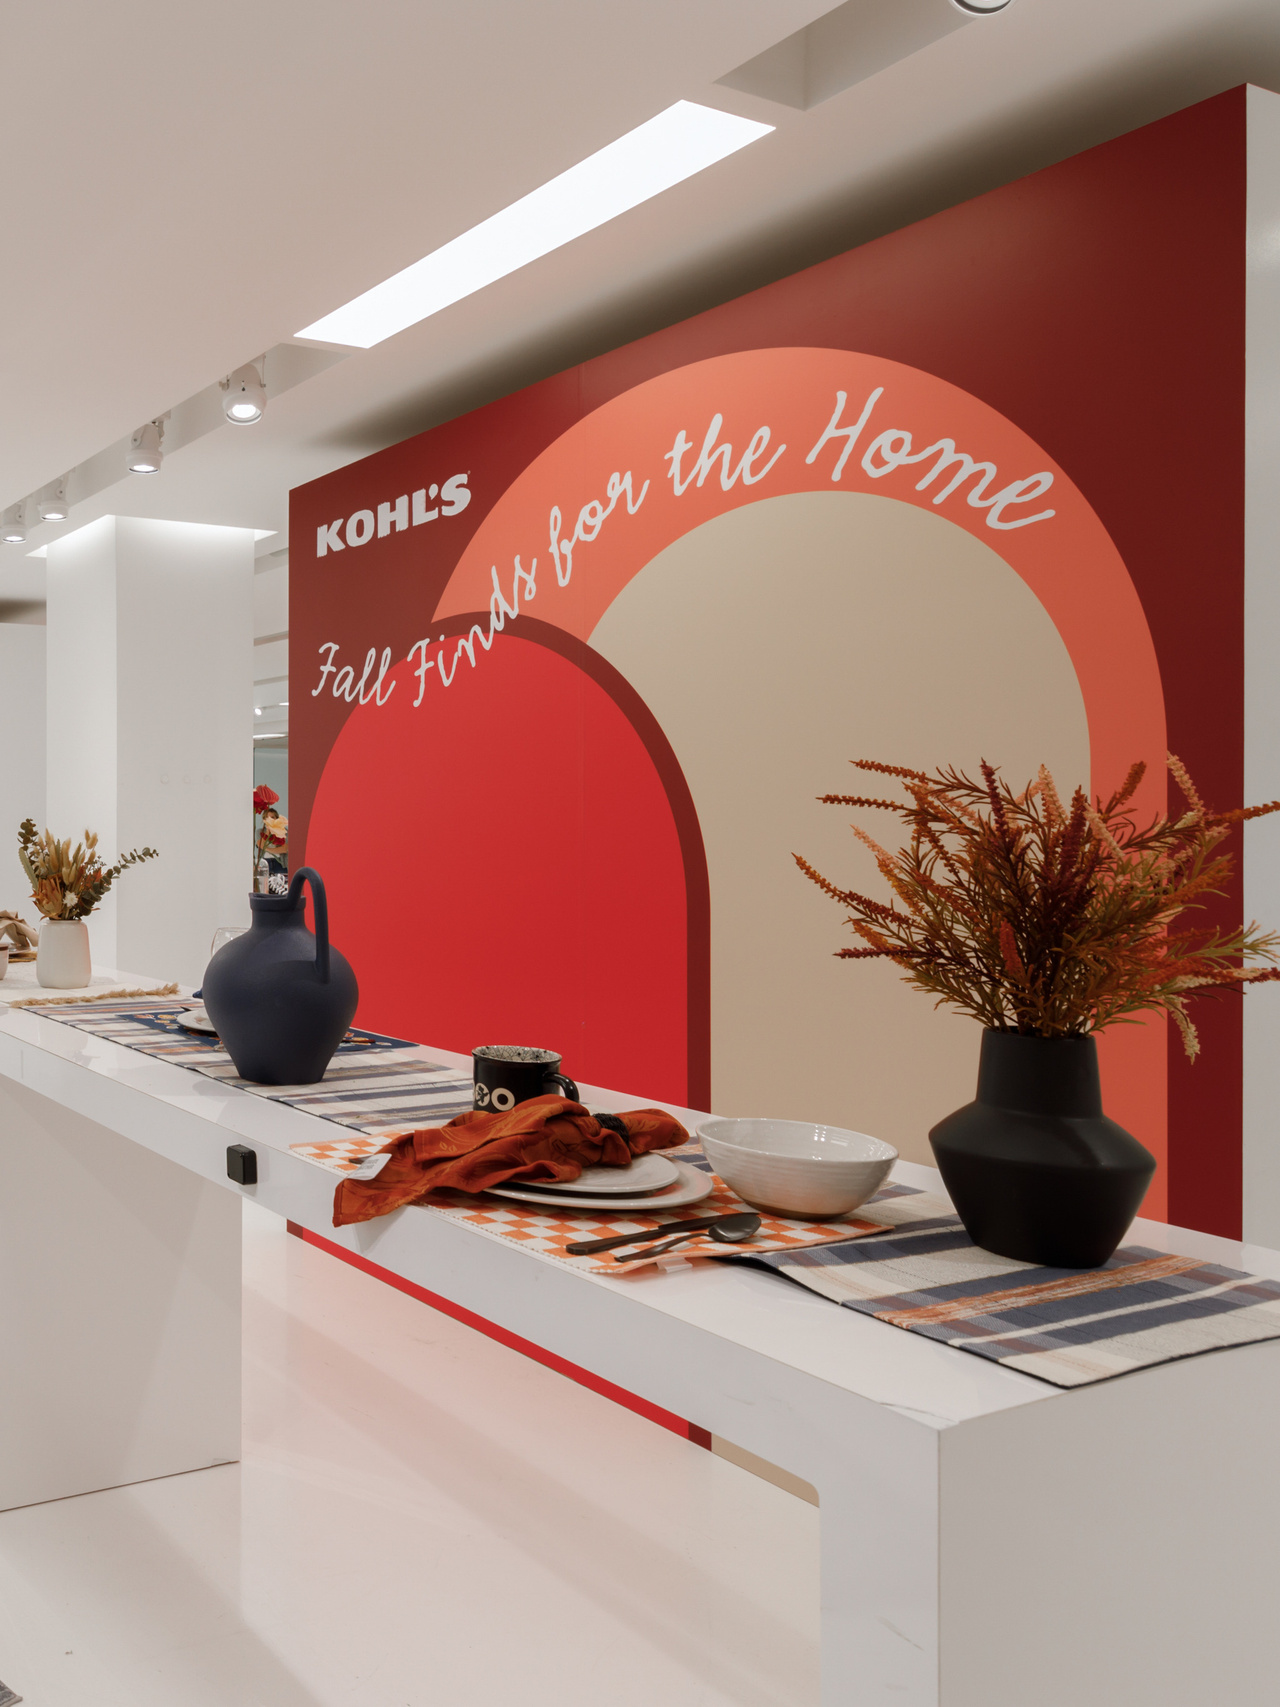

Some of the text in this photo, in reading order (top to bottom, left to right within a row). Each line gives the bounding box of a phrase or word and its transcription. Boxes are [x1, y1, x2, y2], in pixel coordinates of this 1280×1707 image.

[311, 387, 1055, 707] Fall Finds for the Home
[317, 473, 471, 557] KOHL'S
